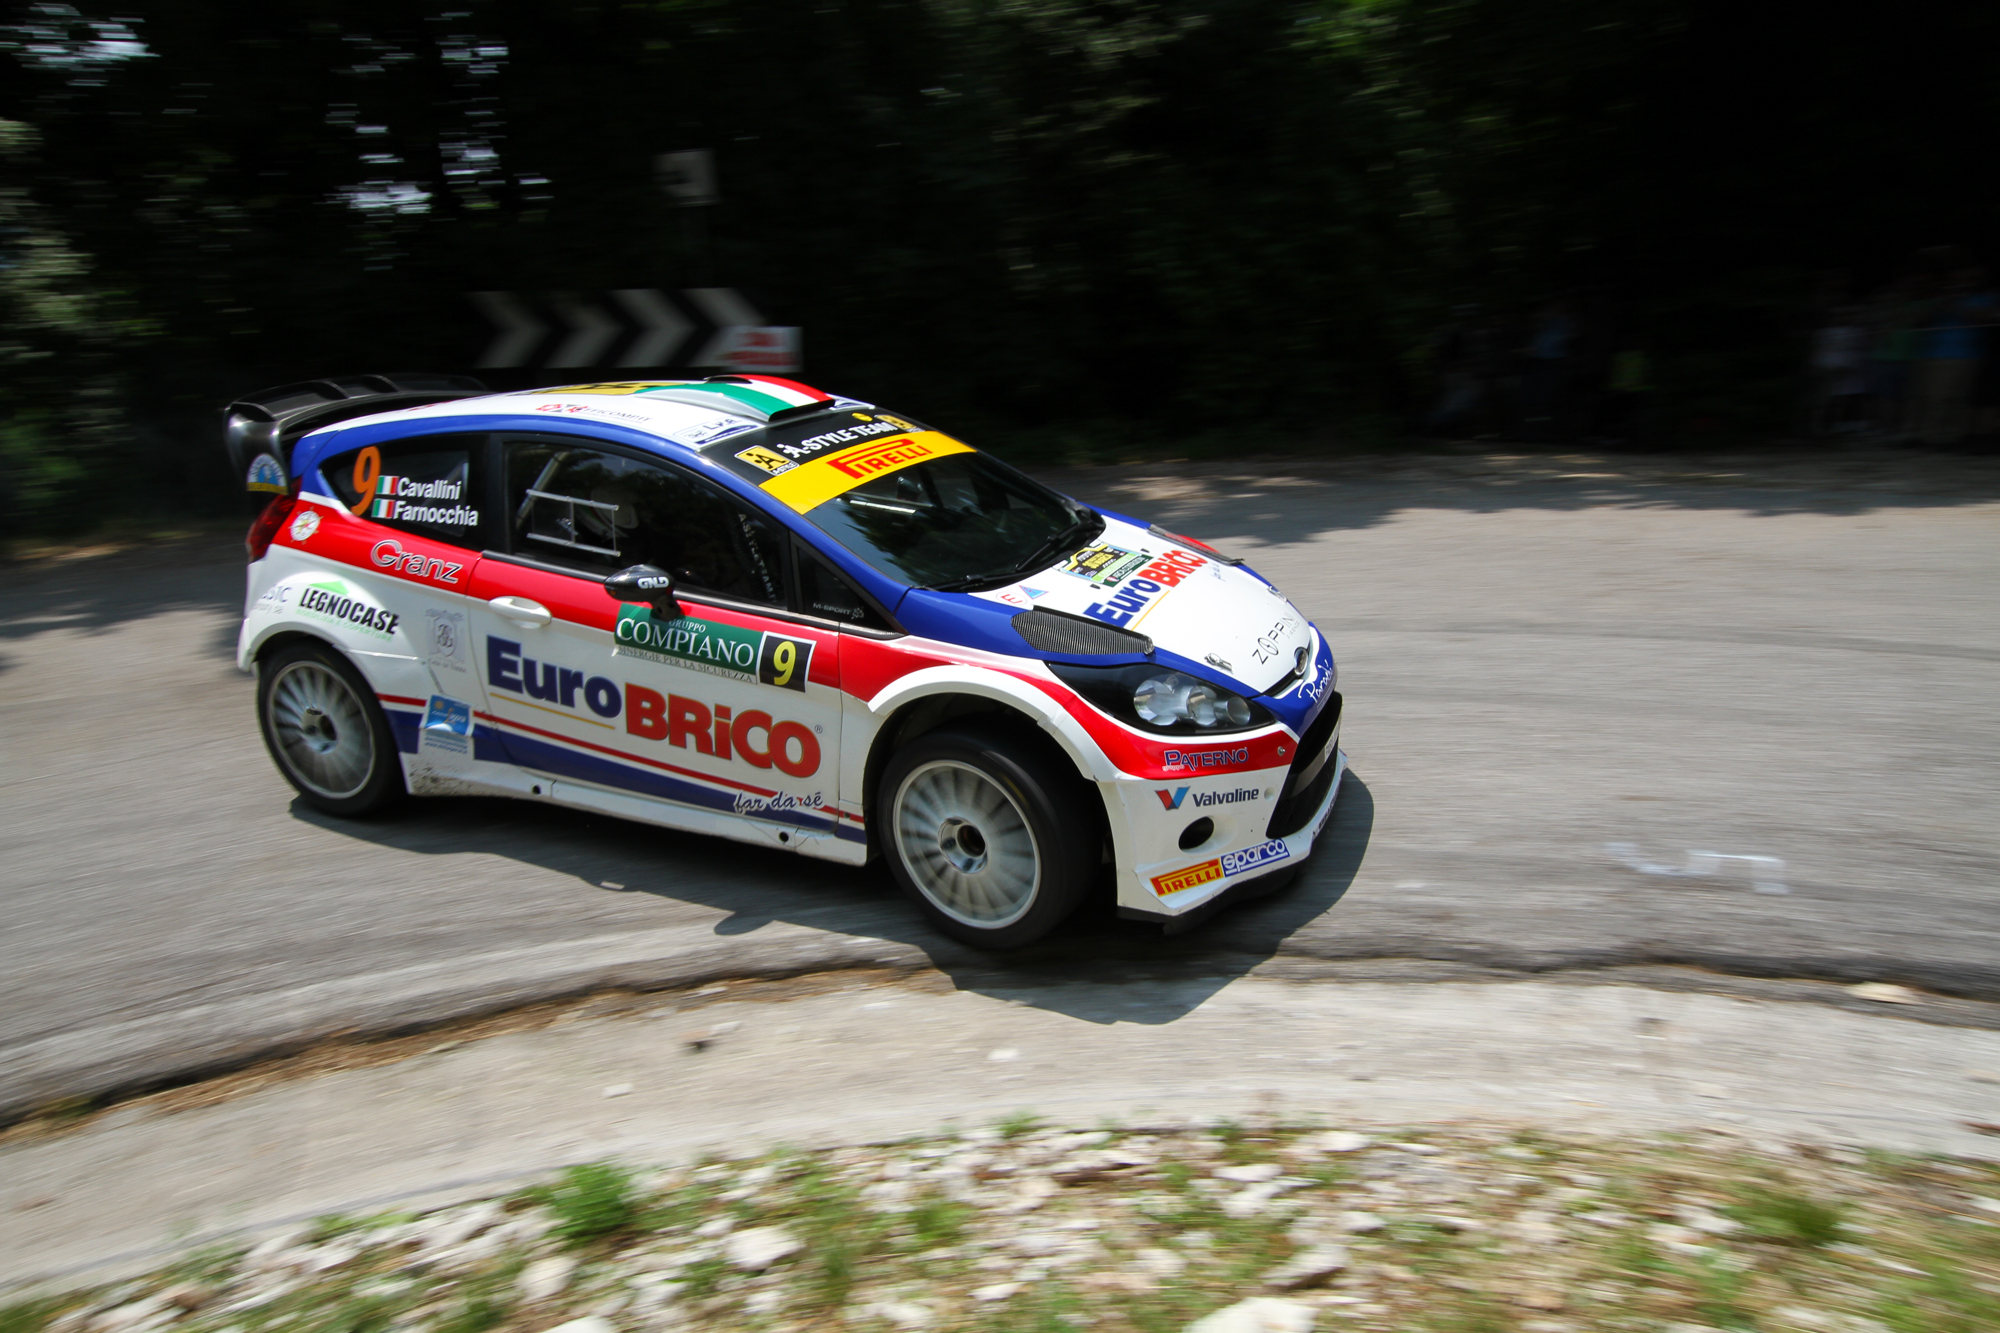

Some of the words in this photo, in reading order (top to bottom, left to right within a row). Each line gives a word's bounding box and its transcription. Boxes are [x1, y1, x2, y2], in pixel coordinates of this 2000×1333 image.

[848, 421, 898, 438] TEAM
[825, 438, 933, 479] PIRELLI
[351, 446, 381, 516] 9
[397, 477, 462, 500] Cavallini
[393, 500, 478, 526] Farnocchia
[300, 588, 400, 635] LEGNOCASE
[668, 619, 706, 634] GRUPPO
[616, 618, 755, 667] COMPIANO
[663, 656, 680, 667] PER
[683, 659, 695, 671] LA
[698, 662, 753, 683] SICUREZZA
[773, 640, 797, 687] 9
[771, 791, 796, 809] da
[1192, 788, 1259, 807] Valvoline
[1223, 839, 1285, 873] sparco
[1150, 858, 1222, 896] PIRELLI
